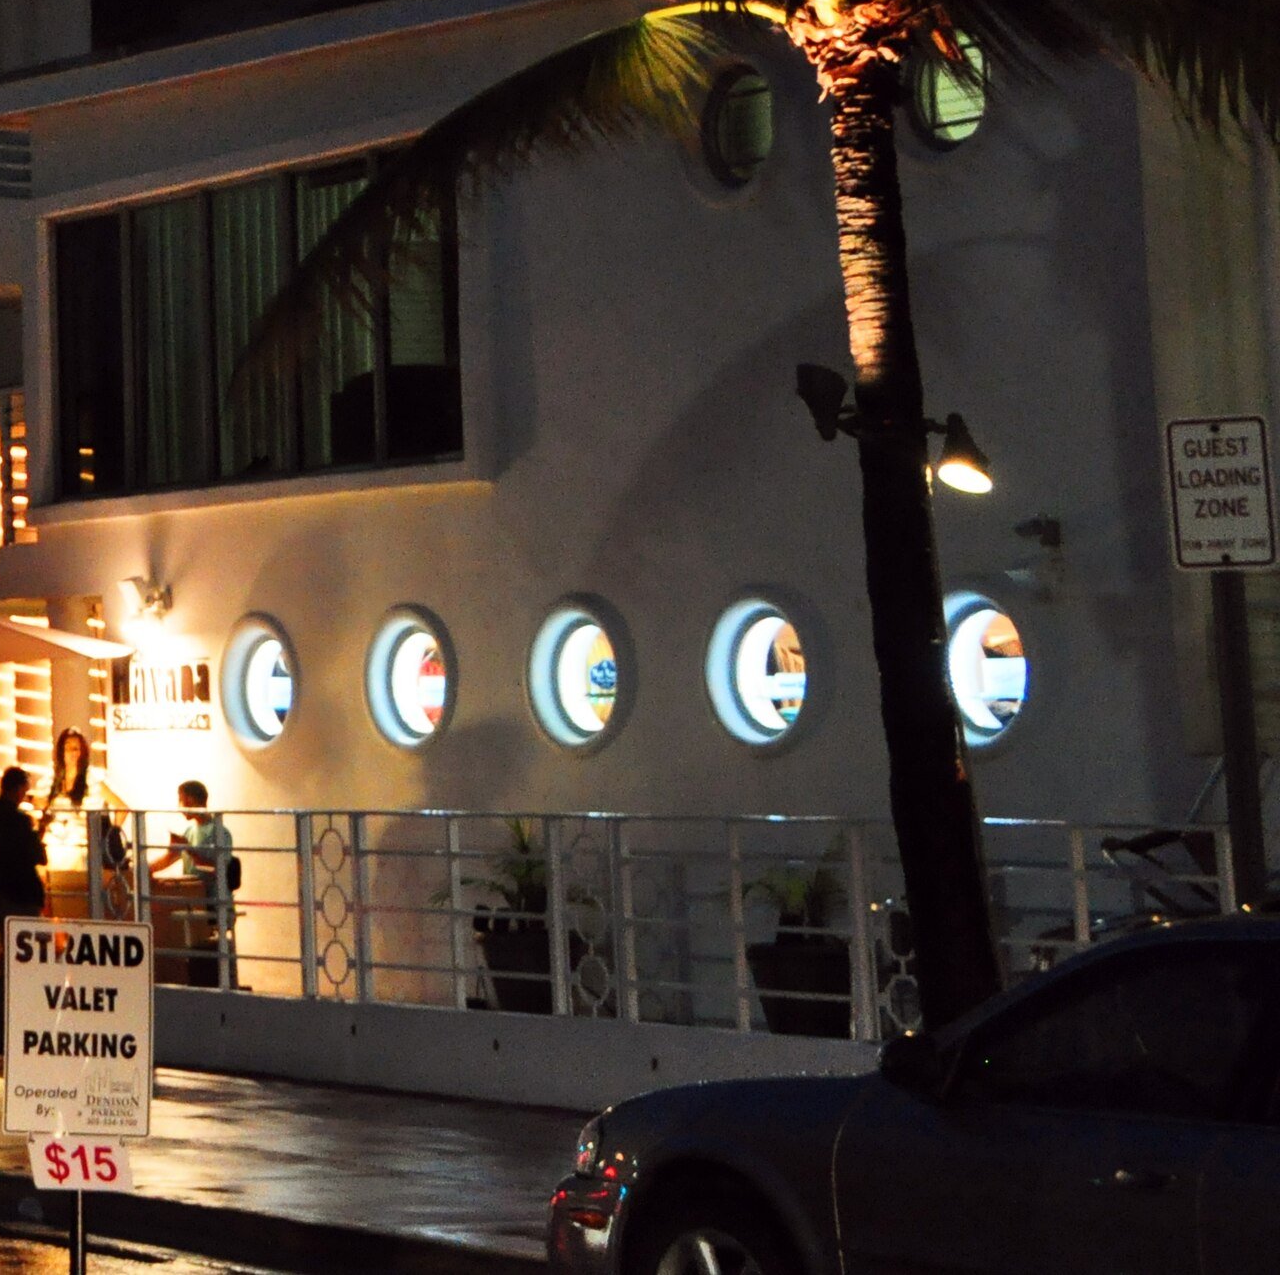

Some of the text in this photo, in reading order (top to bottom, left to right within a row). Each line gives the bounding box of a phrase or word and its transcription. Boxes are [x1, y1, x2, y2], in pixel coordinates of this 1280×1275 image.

[1184, 436, 1248, 457] GUEST
[1177, 467, 1261, 489] LOADING
[1194, 497, 1250, 519] ZONE
[15, 930, 144, 966] STRAND
[44, 984, 119, 1012] VALET
[23, 1030, 138, 1059] PARKING
[14, 1085, 78, 1100] Operated
[44, 1142, 118, 1183] $15
